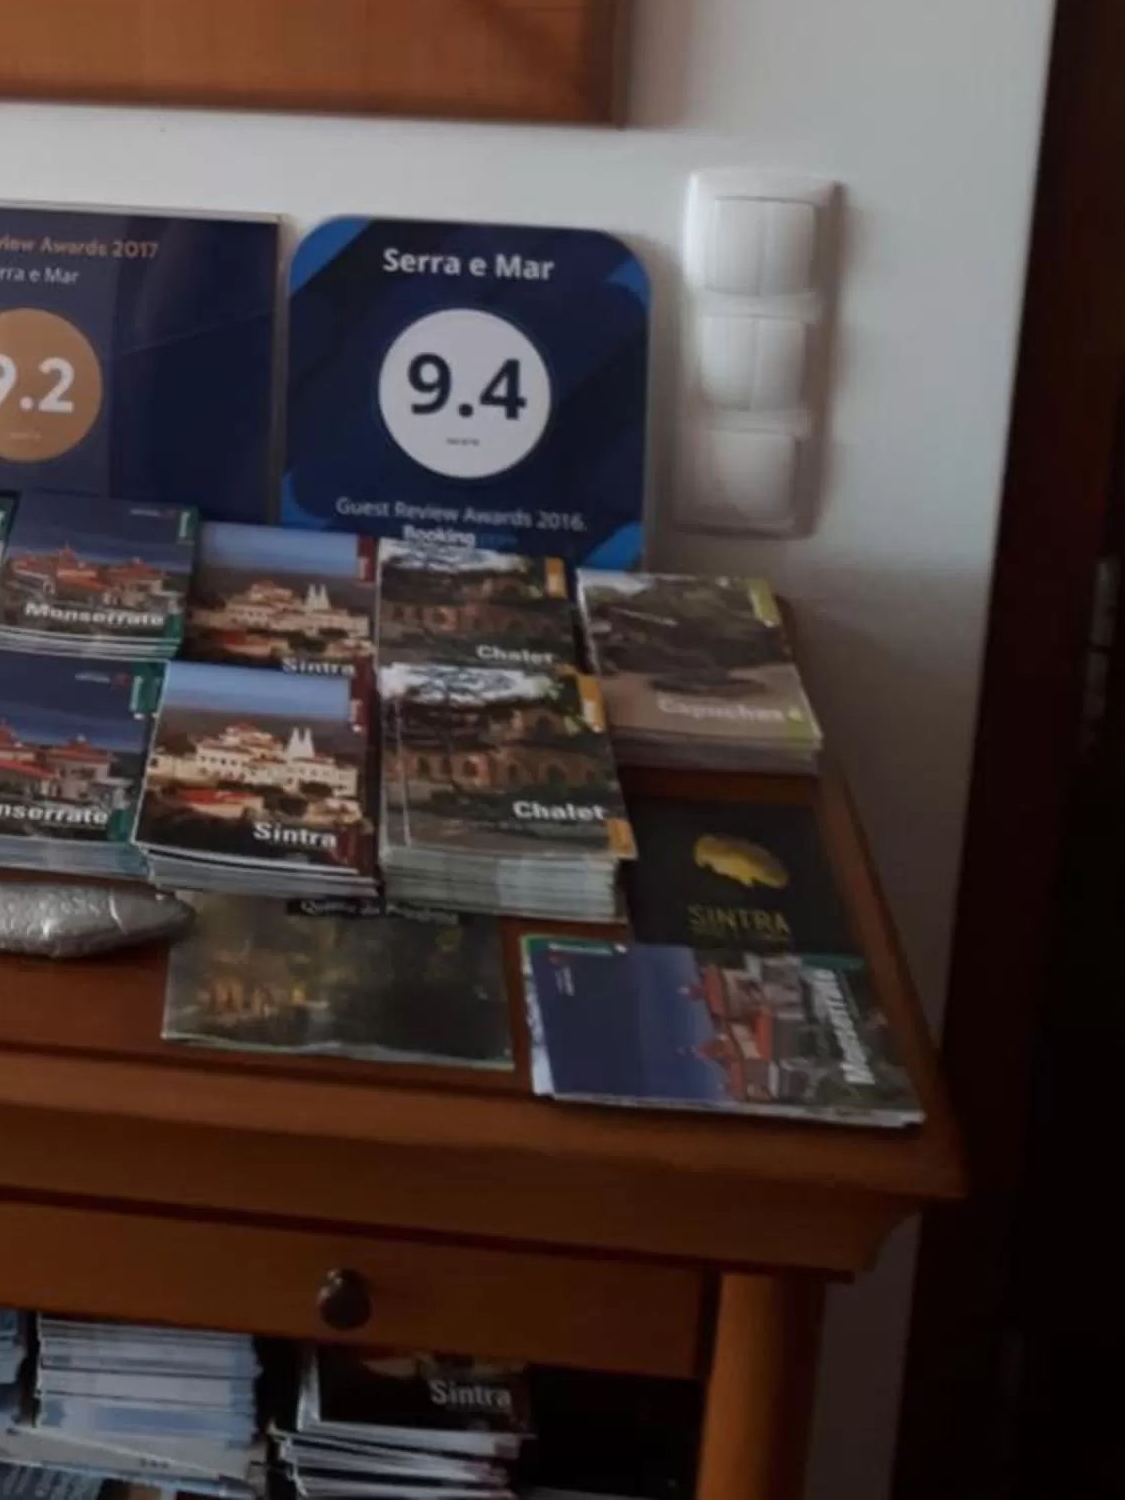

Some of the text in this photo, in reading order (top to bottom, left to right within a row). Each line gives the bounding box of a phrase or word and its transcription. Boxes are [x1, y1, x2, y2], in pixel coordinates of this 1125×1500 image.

[40, 237, 108, 257] Awards
[111, 240, 159, 259] 2017
[29, 268, 42, 283] e
[45, 267, 81, 285] Mar
[383, 248, 556, 281] Serra e Mar
[407, 352, 528, 422] 9.4
[335, 496, 390, 517] Guest
[394, 501, 459, 524] Review
[463, 506, 532, 529] Awards
[24, 601, 165, 627] Monserrate
[281, 656, 356, 677] Sintra
[477, 643, 555, 665] Chalet
[511, 799, 608, 822] Chalet
[252, 821, 338, 848] Sintra
[426, 1379, 513, 1409] Sintra
